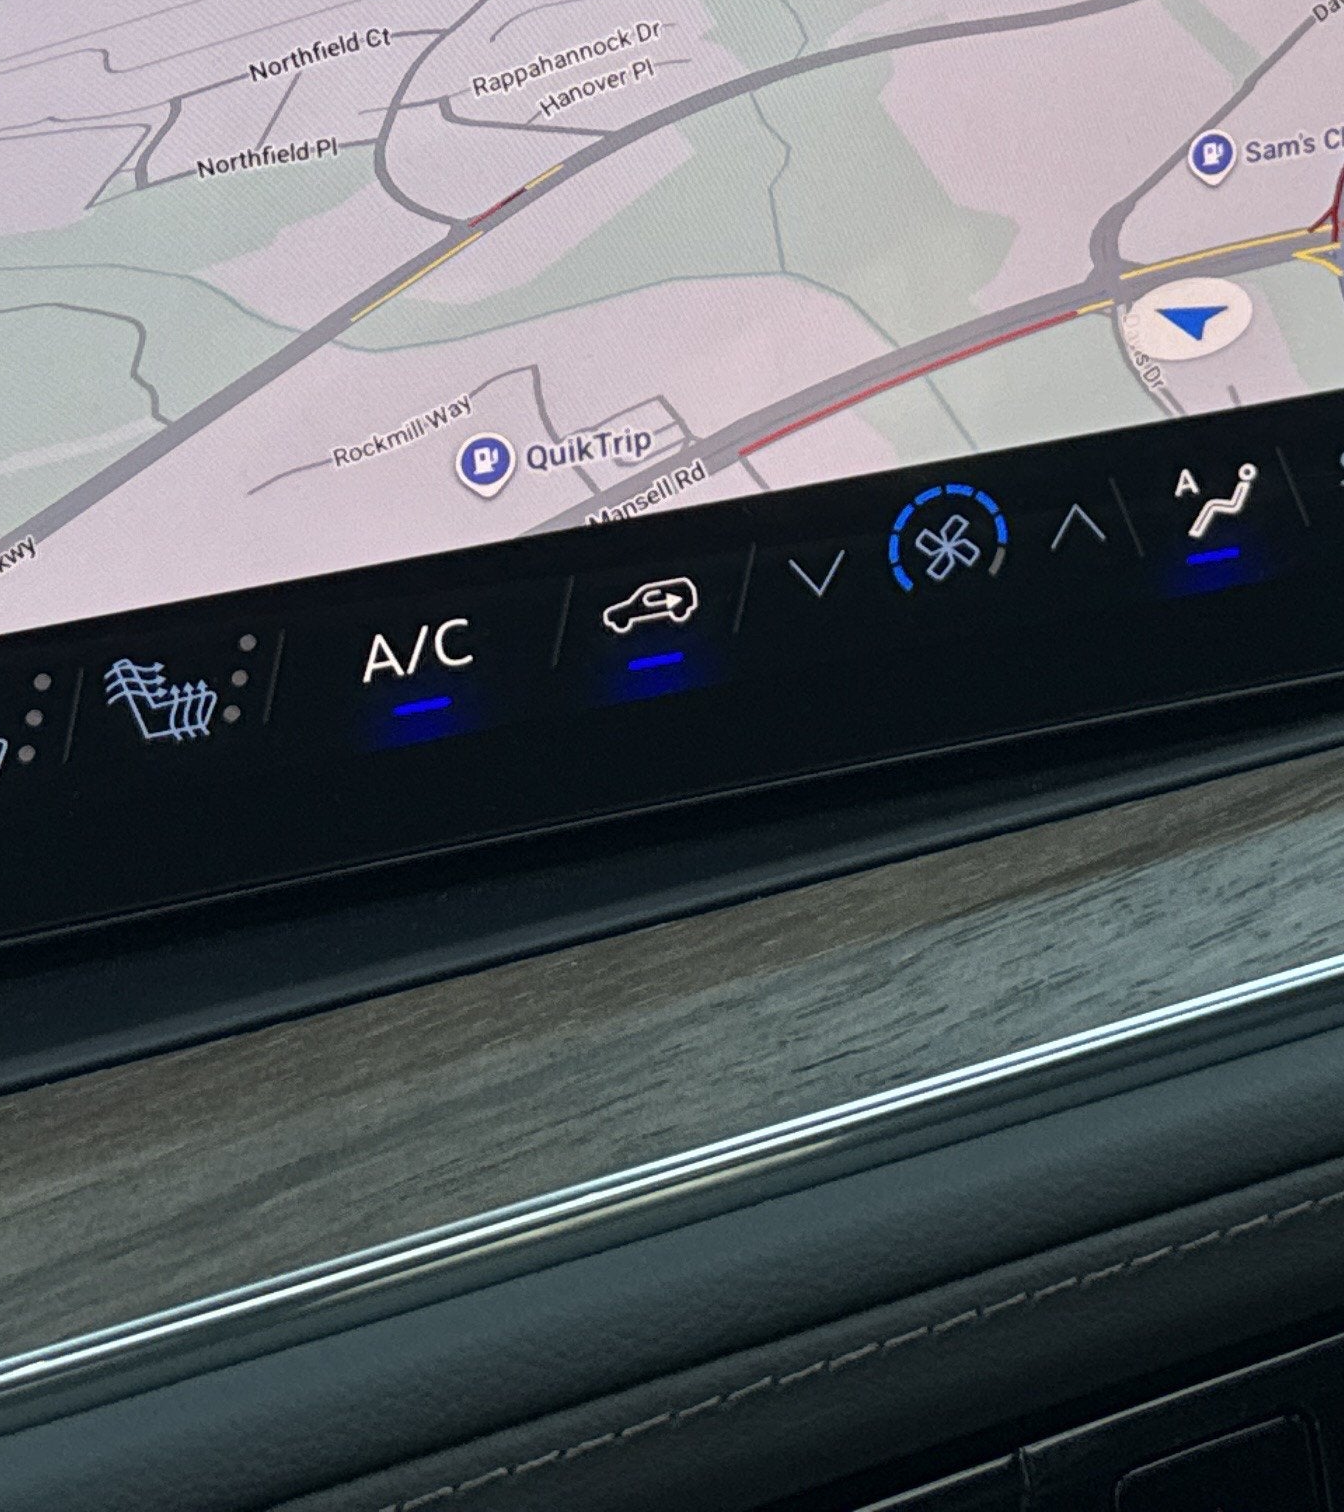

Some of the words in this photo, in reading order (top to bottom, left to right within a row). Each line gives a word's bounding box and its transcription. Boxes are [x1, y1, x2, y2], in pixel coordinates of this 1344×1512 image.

[248, 33, 362, 84] Northfield
[365, 27, 392, 48] Ct
[471, 29, 632, 99] Rappahannock
[635, 21, 662, 44] Dr
[539, 70, 628, 118] Hanover
[630, 58, 655, 82] Pl
[196, 142, 311, 179] Northfield
[314, 136, 339, 160] Pl
[1245, 133, 1317, 164] Sam's
[331, 419, 427, 470] Rockmill
[426, 393, 474, 432] Way
[525, 428, 653, 472] QuikTrip
[673, 460, 707, 491] Rd
[1173, 468, 1201, 497] A
[361, 617, 475, 685] A/C
